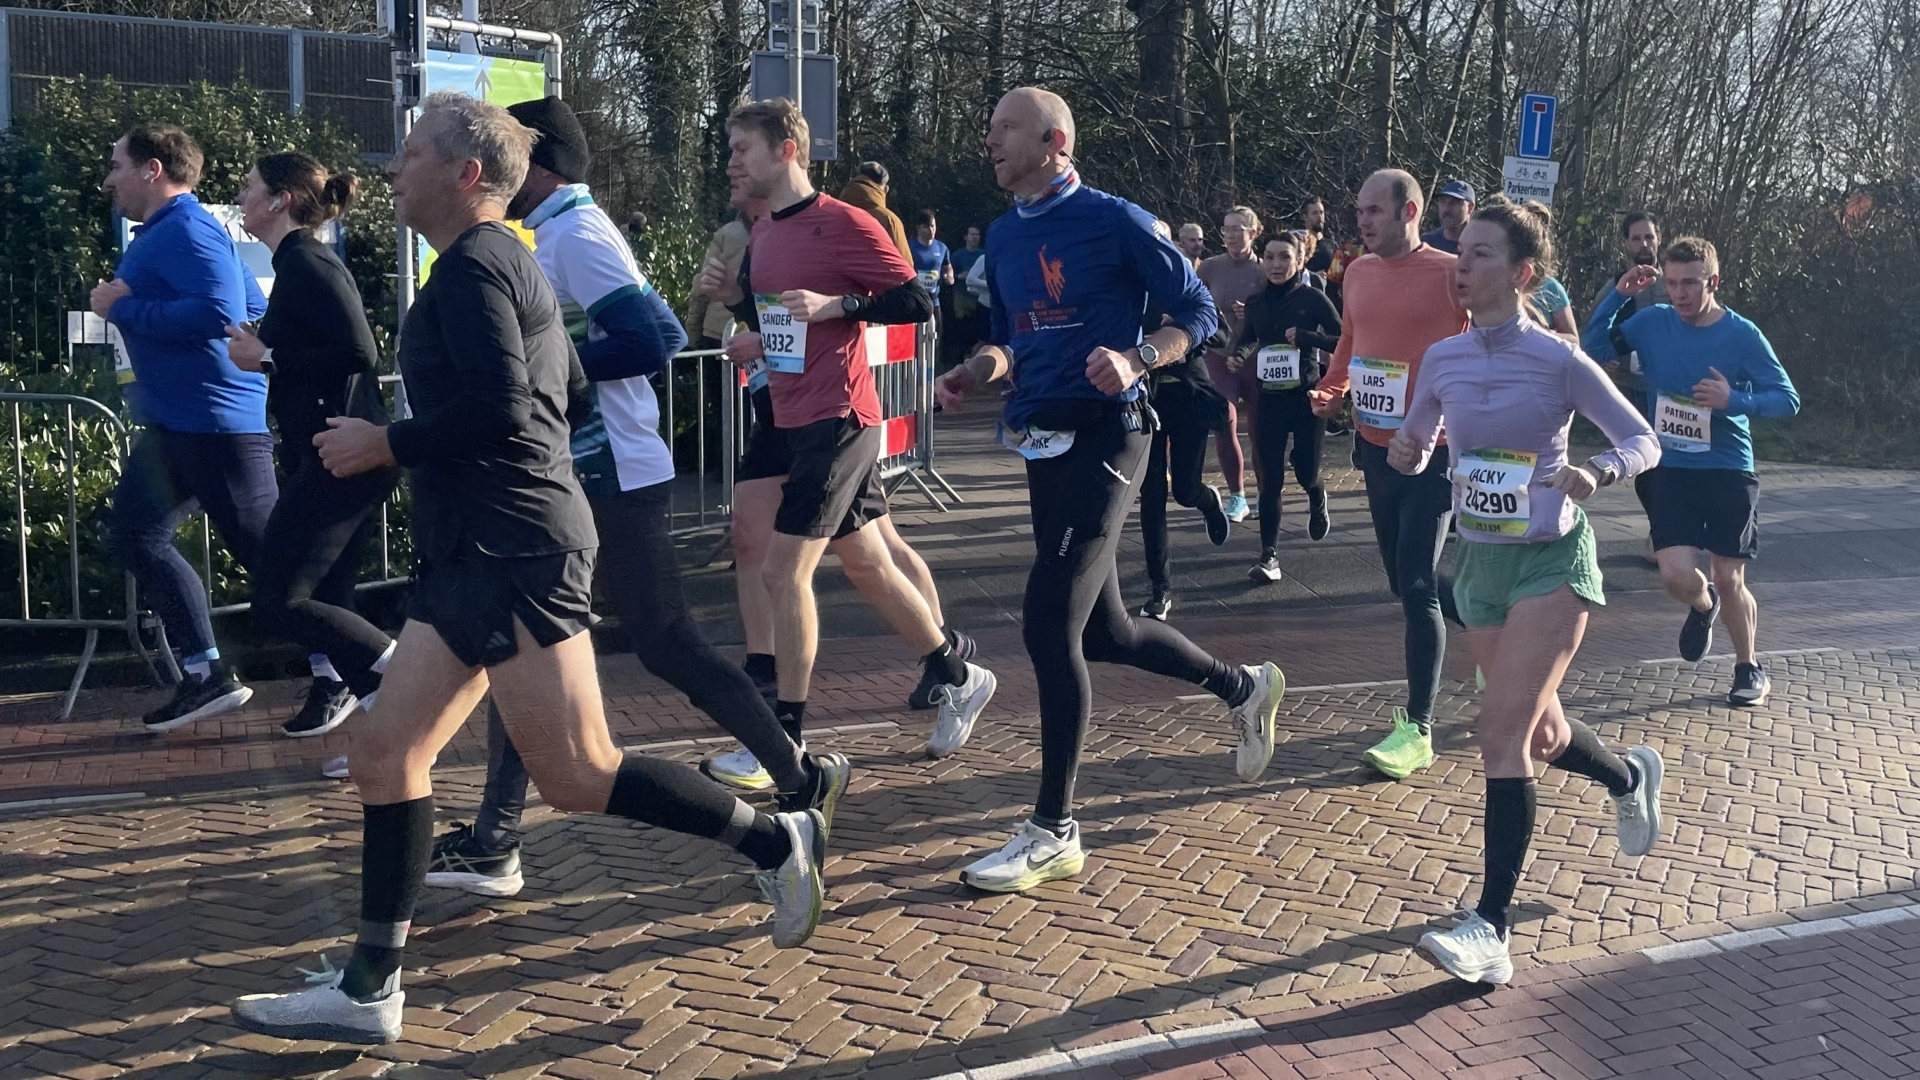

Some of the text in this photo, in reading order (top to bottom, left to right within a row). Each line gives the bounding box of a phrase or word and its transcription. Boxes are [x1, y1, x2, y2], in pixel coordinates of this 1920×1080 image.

[1507, 181, 1550, 197] Parkeerterrein
[762, 313, 792, 327] SANDER
[1028, 311, 1040, 331] 2023
[761, 333, 794, 353] 34332
[1266, 355, 1289, 364] BIRCAN
[1263, 367, 1293, 380] 24891
[1363, 374, 1385, 388] LARS
[1355, 390, 1395, 413] 34073
[1665, 405, 1699, 422] PATRICK
[1660, 419, 1703, 439] 34604
[1465, 485, 1518, 514] 24290
[1488, 523, 1501, 533] KM
[1059, 526, 1074, 557] FUSION
